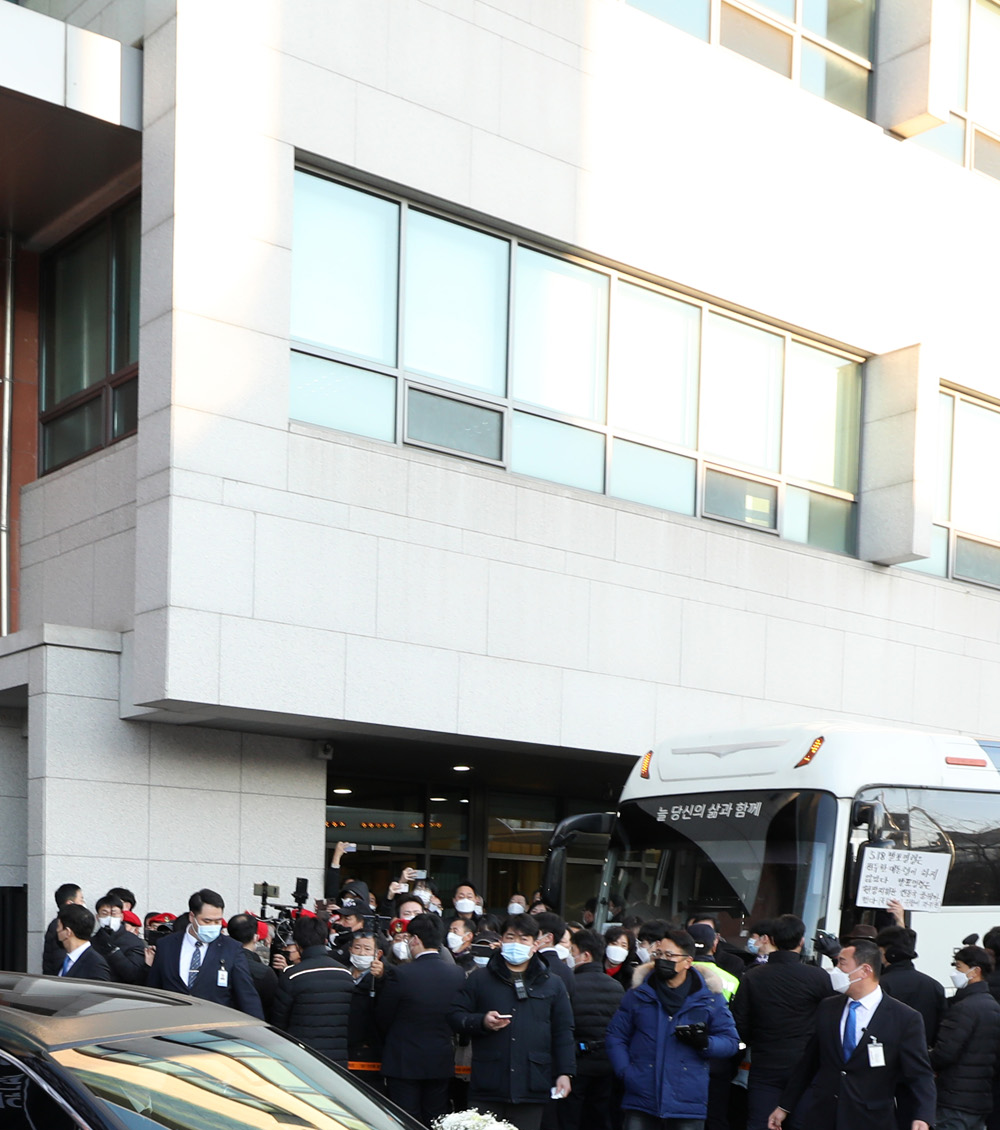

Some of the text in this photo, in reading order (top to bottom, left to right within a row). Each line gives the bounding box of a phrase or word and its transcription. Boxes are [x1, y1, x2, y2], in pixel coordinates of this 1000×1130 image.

[657, 802, 762, 821] 늘 당신의 삶과 함께
